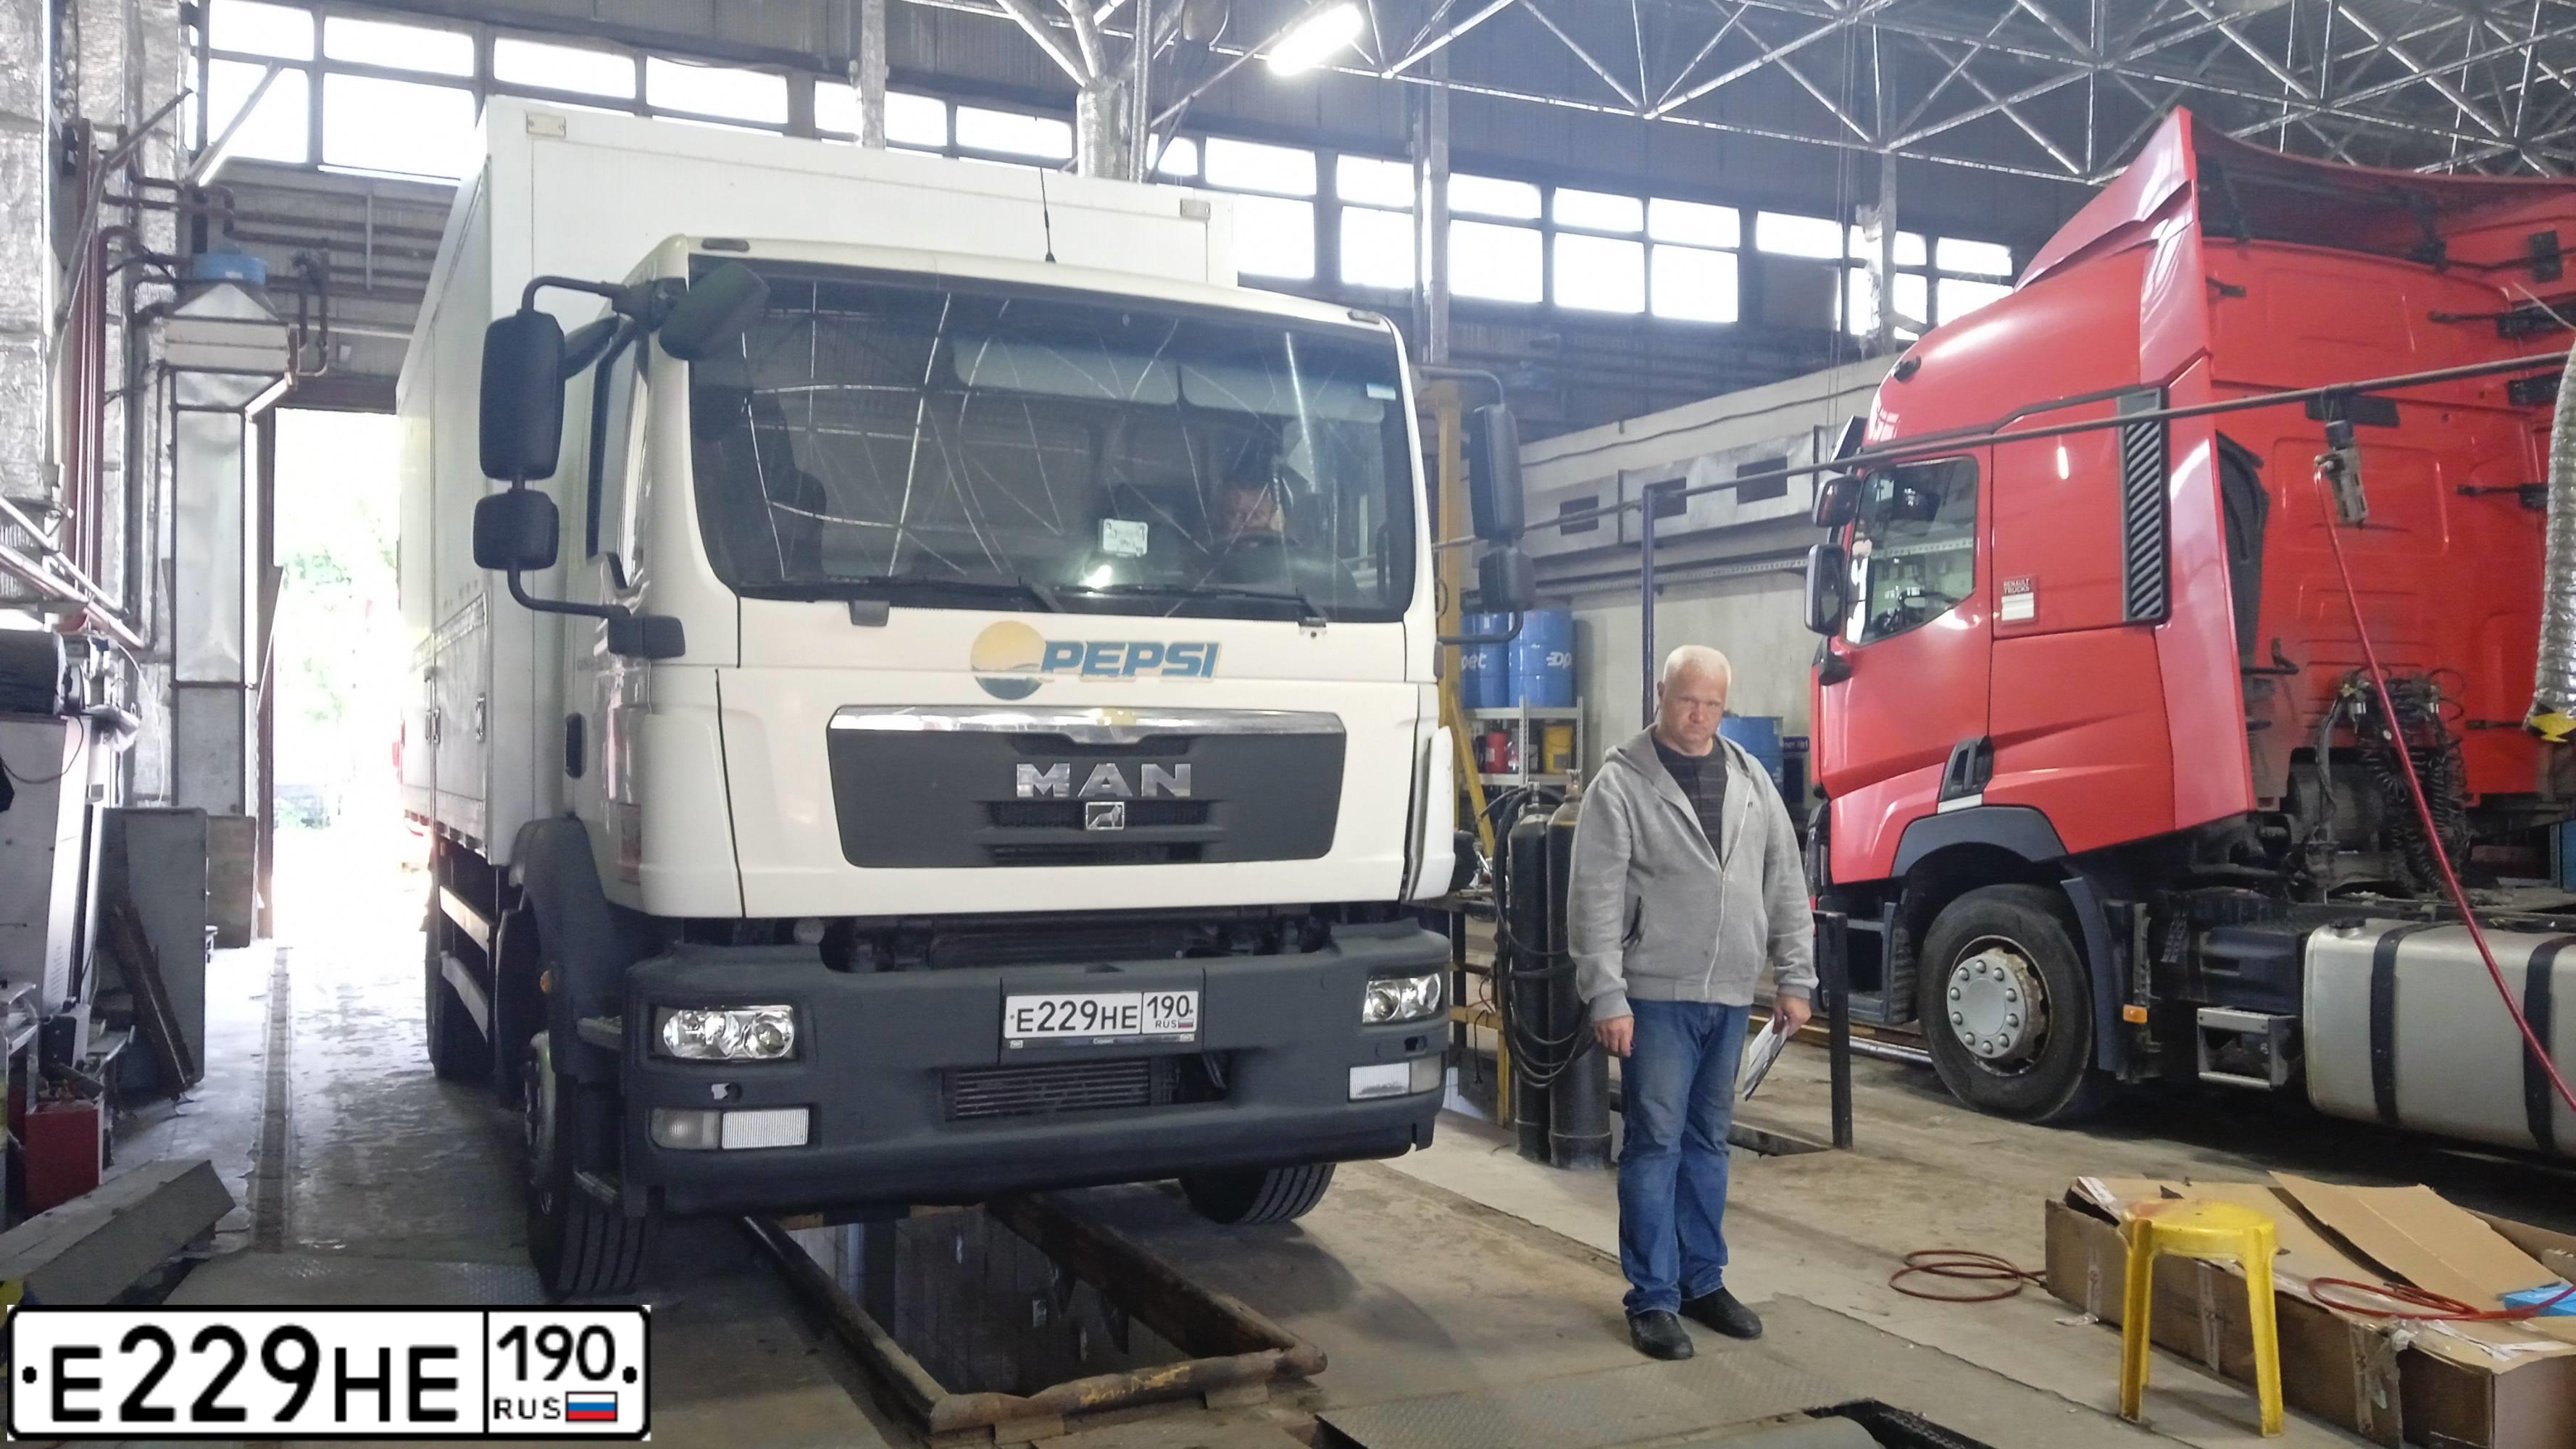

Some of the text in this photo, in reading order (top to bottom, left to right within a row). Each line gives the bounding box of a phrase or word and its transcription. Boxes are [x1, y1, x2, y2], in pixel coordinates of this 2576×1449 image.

[1041, 640, 1220, 677] PEPSI
[1016, 763, 1191, 798] MAN
[1146, 995, 1190, 1019] 190
[1155, 1019, 1177, 1029] RUS
